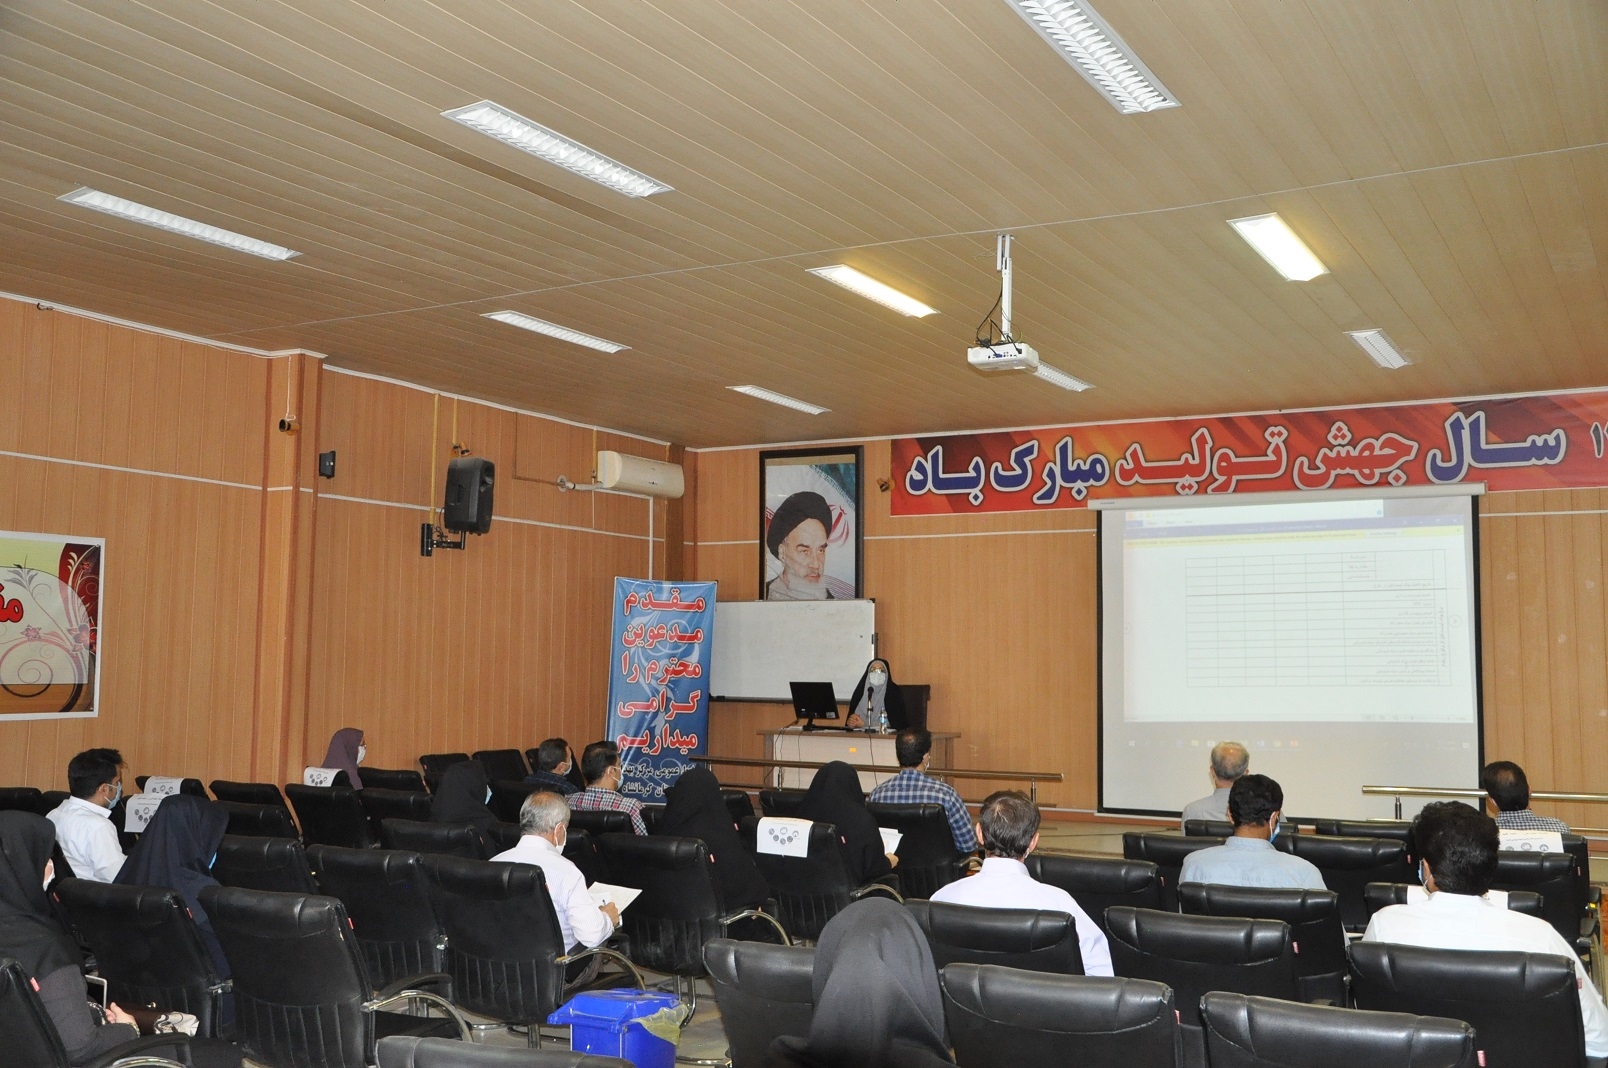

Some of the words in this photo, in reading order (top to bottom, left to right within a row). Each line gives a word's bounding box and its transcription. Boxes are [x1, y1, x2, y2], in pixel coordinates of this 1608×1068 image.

[1115, 426, 1288, 495] تولید
[1293, 421, 1418, 490] جهش
[1425, 410, 1567, 484] سال
[905, 445, 986, 506] باد
[990, 436, 1110, 506] مبارک
[624, 588, 705, 616] مقدم
[622, 624, 703, 649] مدعوین
[621, 650, 640, 683] را
[645, 657, 702, 685] محترم
[617, 688, 701, 720] گرامی
[616, 723, 698, 755] میداریم
[635, 763, 654, 778] مرکز
[655, 766, 680, 778] عمومی
[622, 782, 653, 797] کرمانشاه
